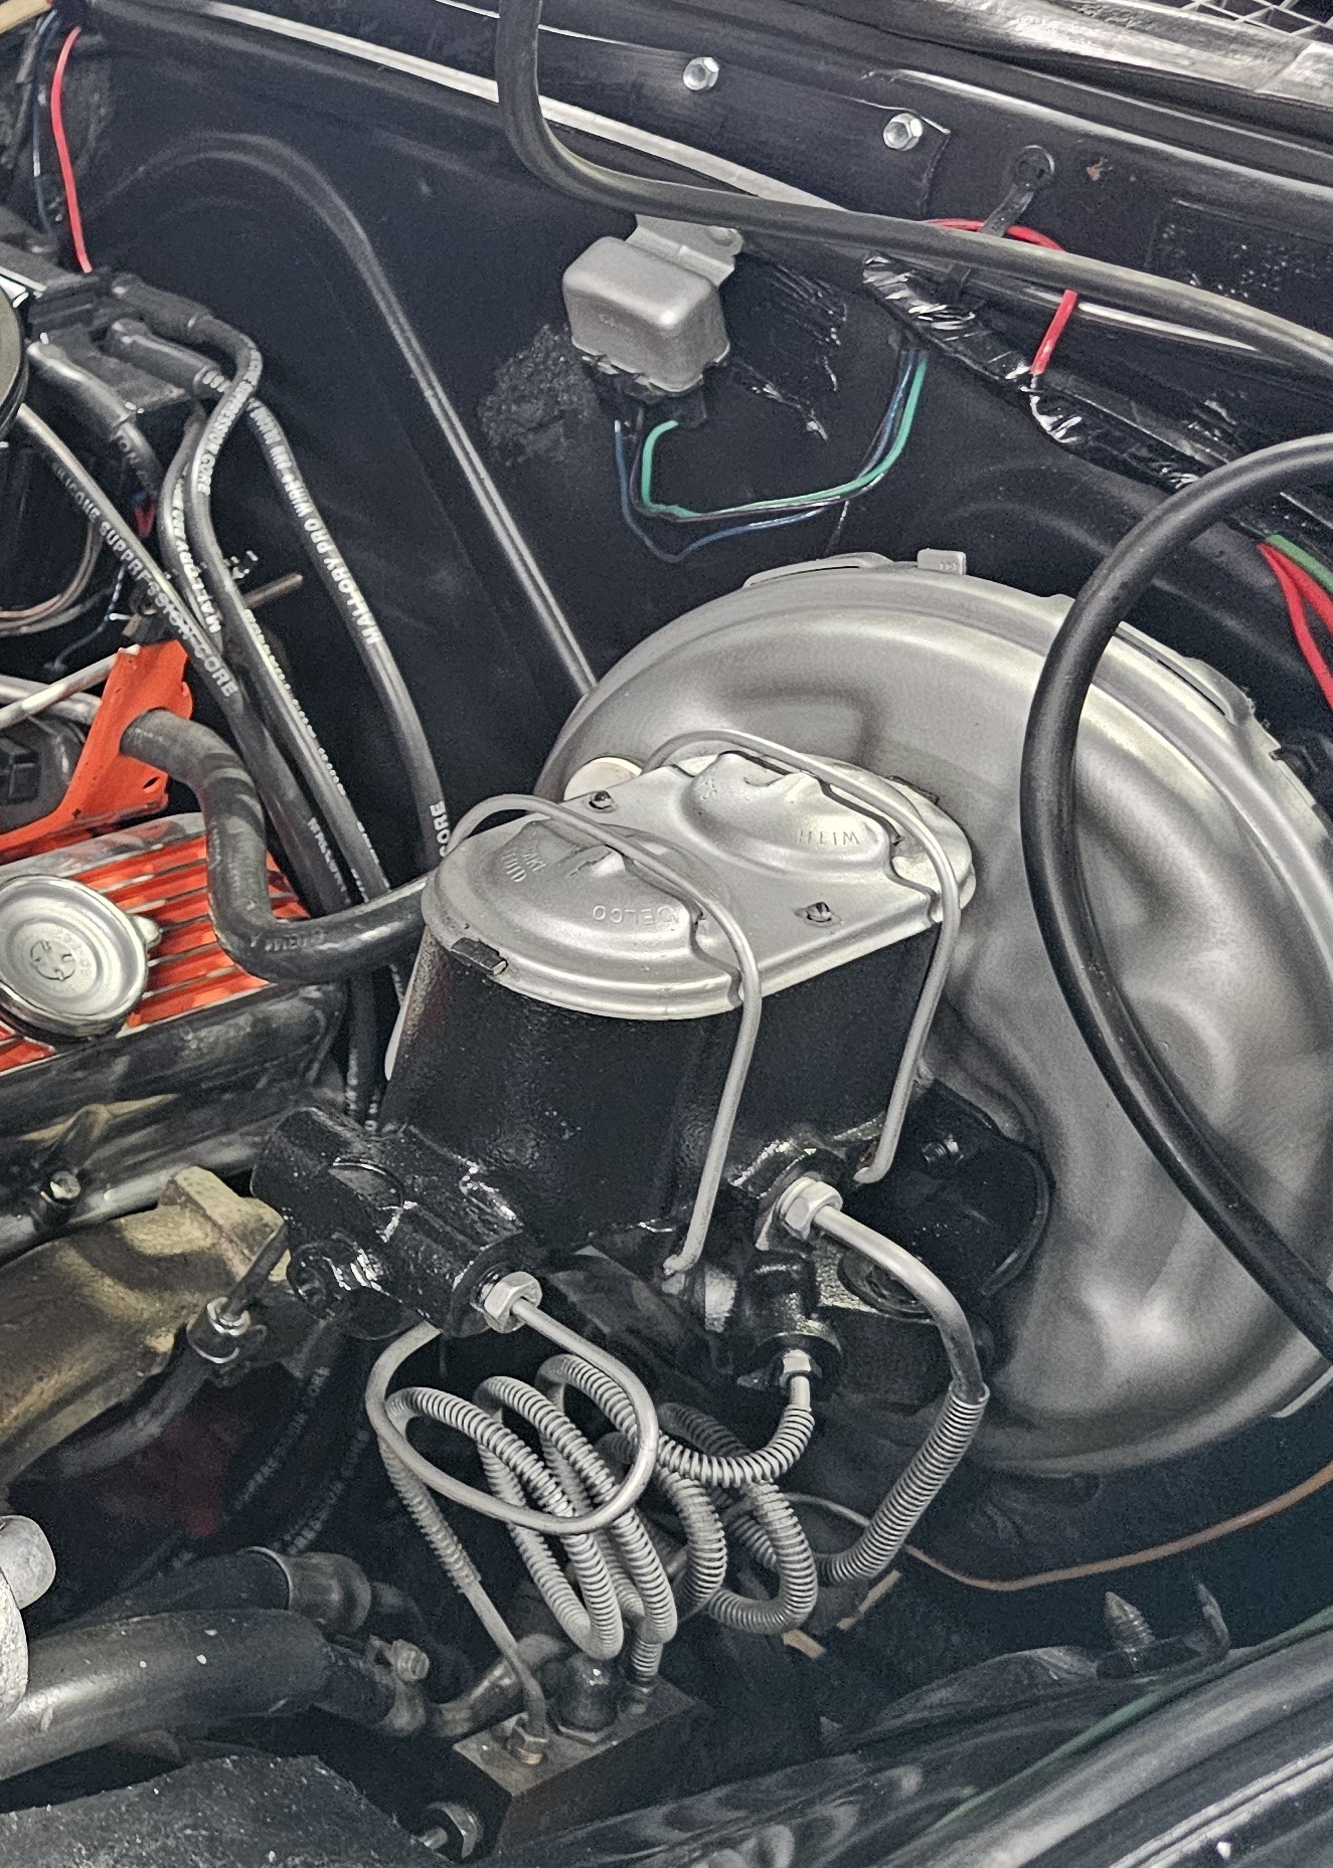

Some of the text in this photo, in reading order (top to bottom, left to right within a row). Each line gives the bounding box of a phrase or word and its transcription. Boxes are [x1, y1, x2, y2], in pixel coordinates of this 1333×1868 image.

[197, 453, 216, 496] CORE
[304, 518, 334, 554] PRO
[100, 520, 197, 641] SUPPRESSION
[193, 640, 240, 697] CORE
[175, 539, 221, 634] MALLORY
[323, 557, 384, 645] MALLORY
[429, 800, 451, 858] CORE
